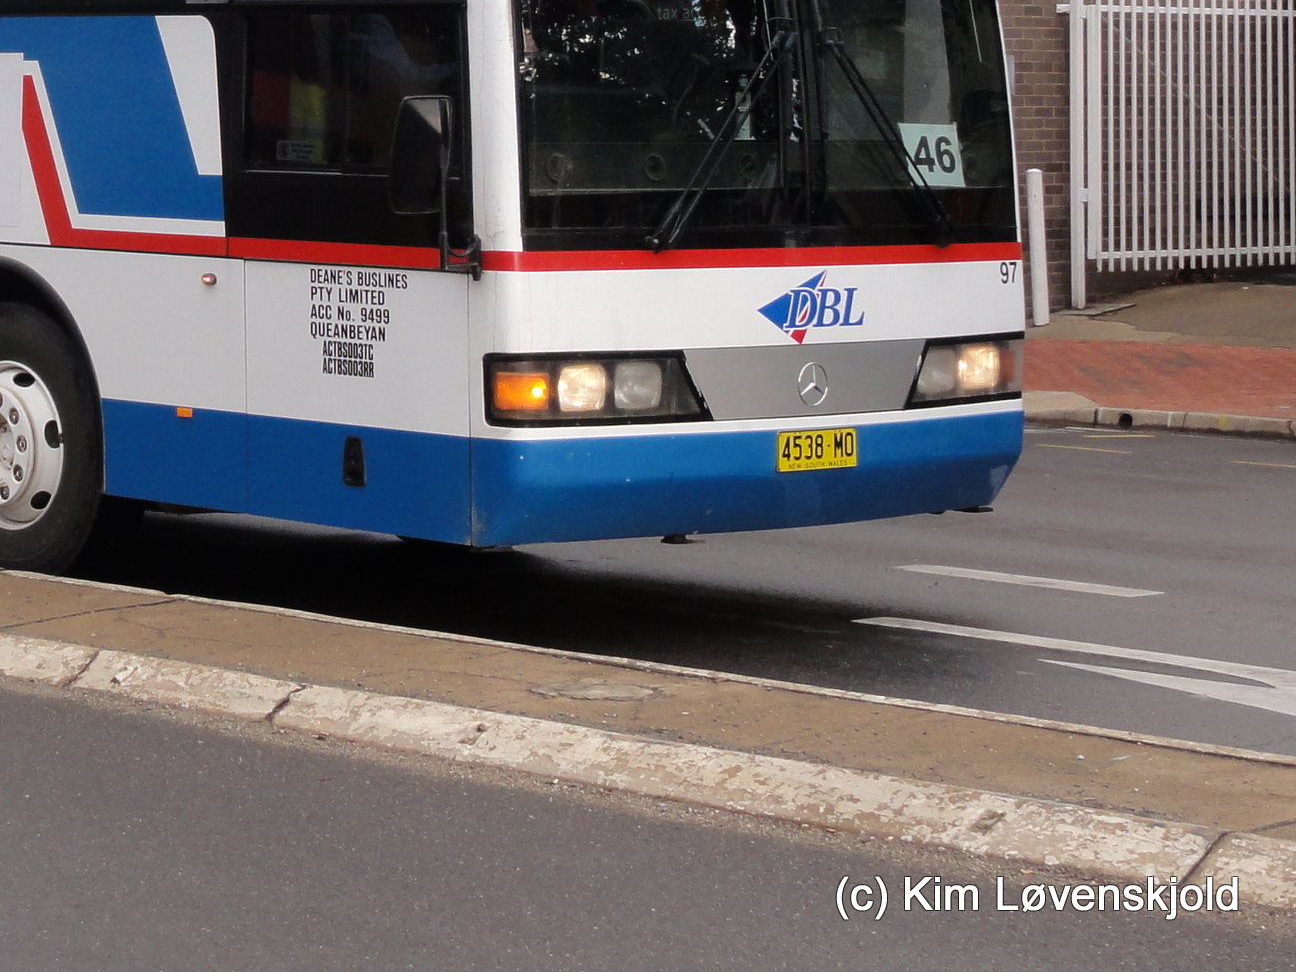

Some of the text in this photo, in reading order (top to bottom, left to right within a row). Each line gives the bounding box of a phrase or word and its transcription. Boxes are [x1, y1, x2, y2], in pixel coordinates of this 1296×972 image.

[913, 134, 956, 174] 46
[310, 268, 408, 290] DEANE'S BUSLINES
[1000, 261, 1017, 284] 97
[310, 286, 385, 306] PTY LIMITED
[310, 303, 390, 325] ACC No. 9499
[783, 287, 866, 331] DBL
[310, 322, 386, 342] QUEANBEYAN
[781, 433, 824, 462] 4538
[804, 461, 826, 469] SOUTH
[828, 459, 848, 467] WALES
